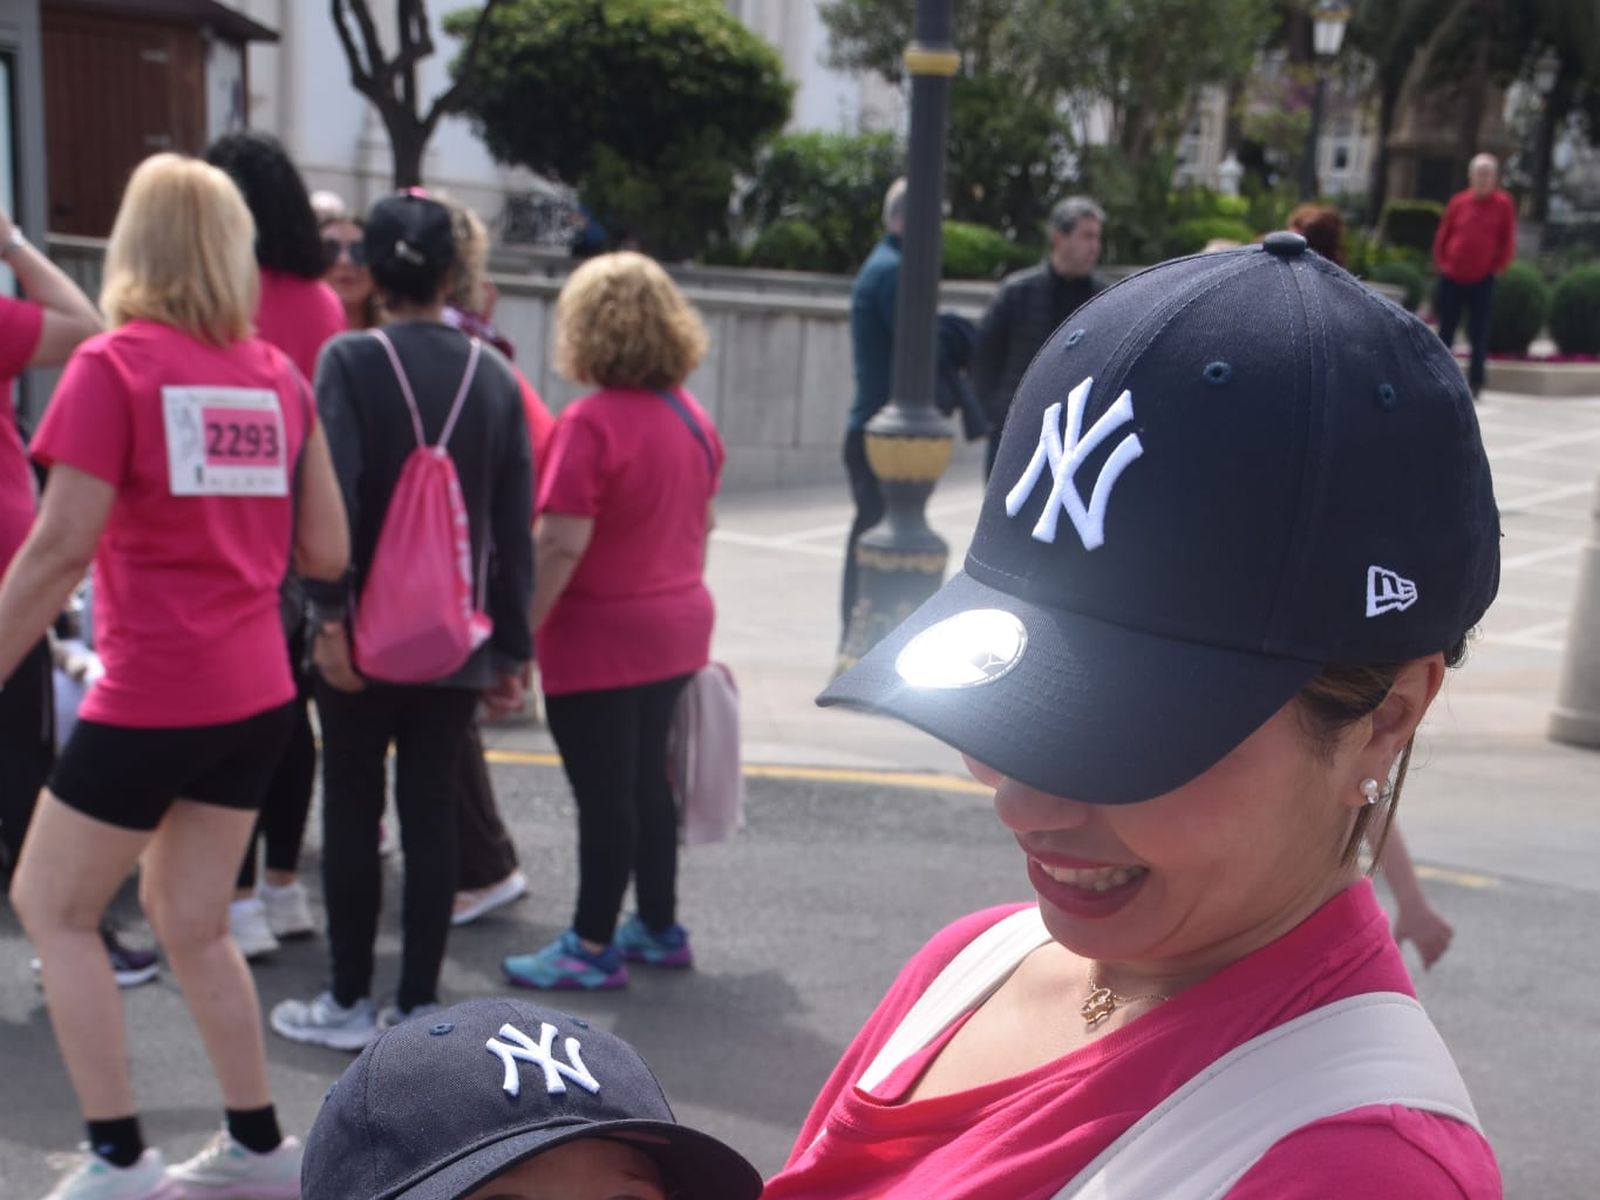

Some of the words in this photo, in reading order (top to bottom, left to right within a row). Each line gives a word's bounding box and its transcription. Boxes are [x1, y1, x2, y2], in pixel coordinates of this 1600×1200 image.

[207, 421, 280, 459] 2293
[1005, 375, 1145, 551] NY
[486, 1021, 601, 1097] NY
